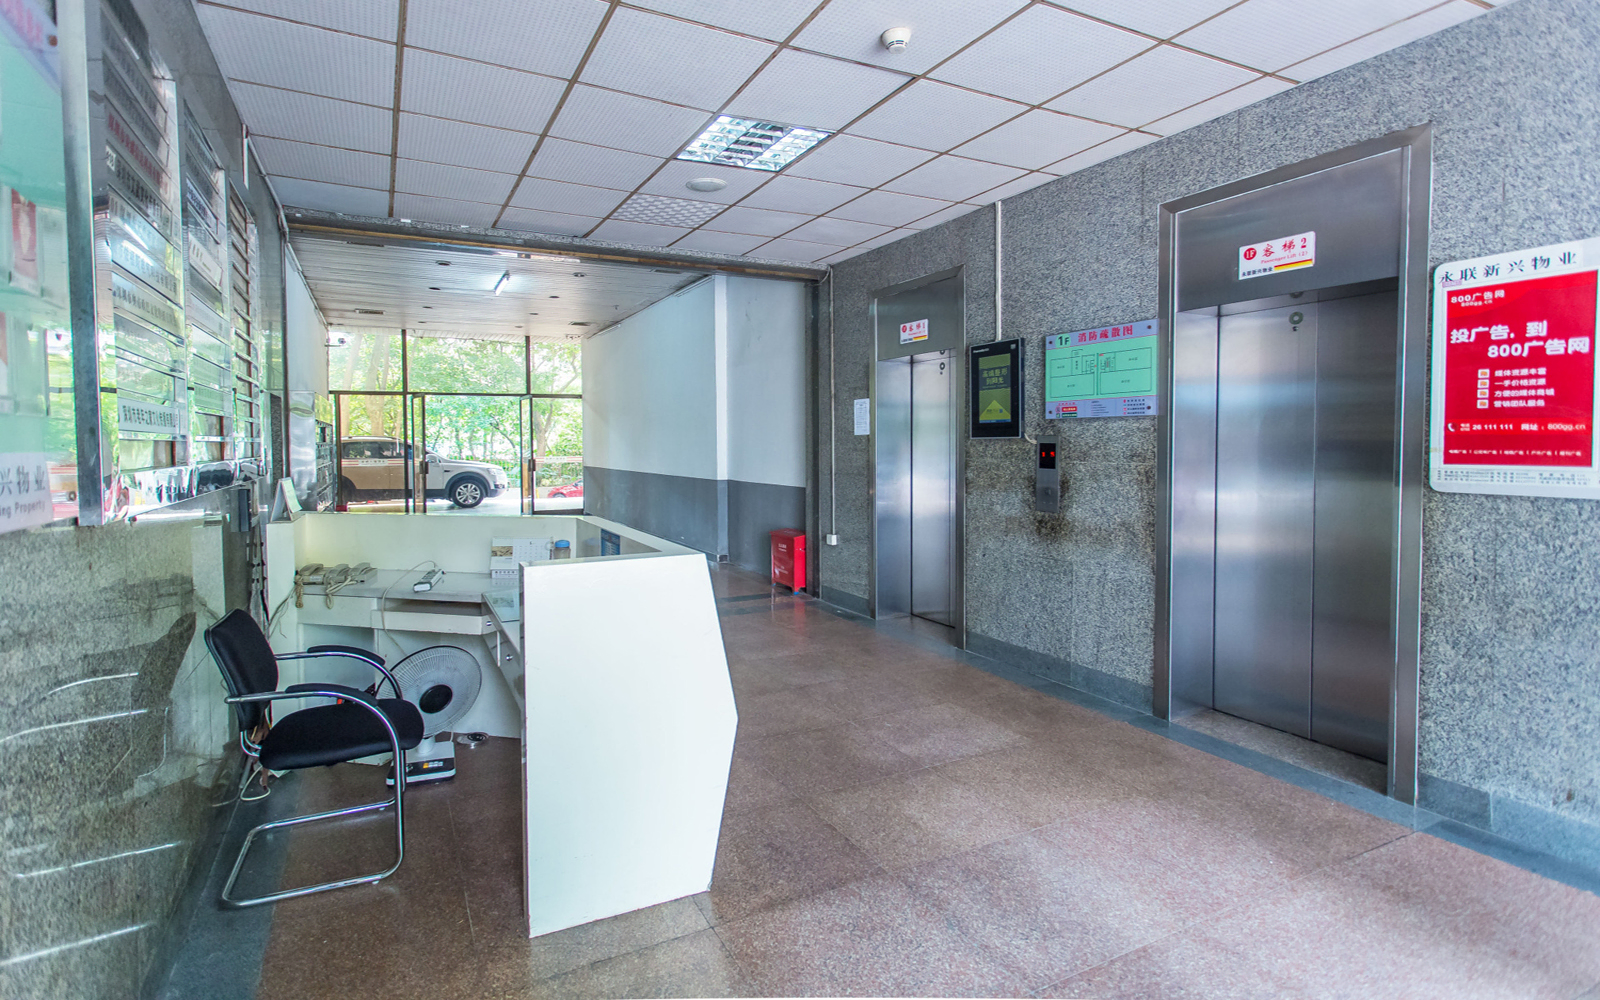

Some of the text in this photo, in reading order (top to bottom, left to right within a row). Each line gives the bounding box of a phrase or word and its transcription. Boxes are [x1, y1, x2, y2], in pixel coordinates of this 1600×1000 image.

[1439, 252, 1577, 284] 永联新兴物业
[1451, 289, 1505, 304] 800广告网
[1461, 299, 1493, 307] 800gg.cn
[1058, 336, 1070, 346] 1F
[1078, 324, 1134, 343] 消防疏散图
[1487, 337, 1590, 358] 800广告网
[1547, 423, 1586, 431] 800gg.cn
